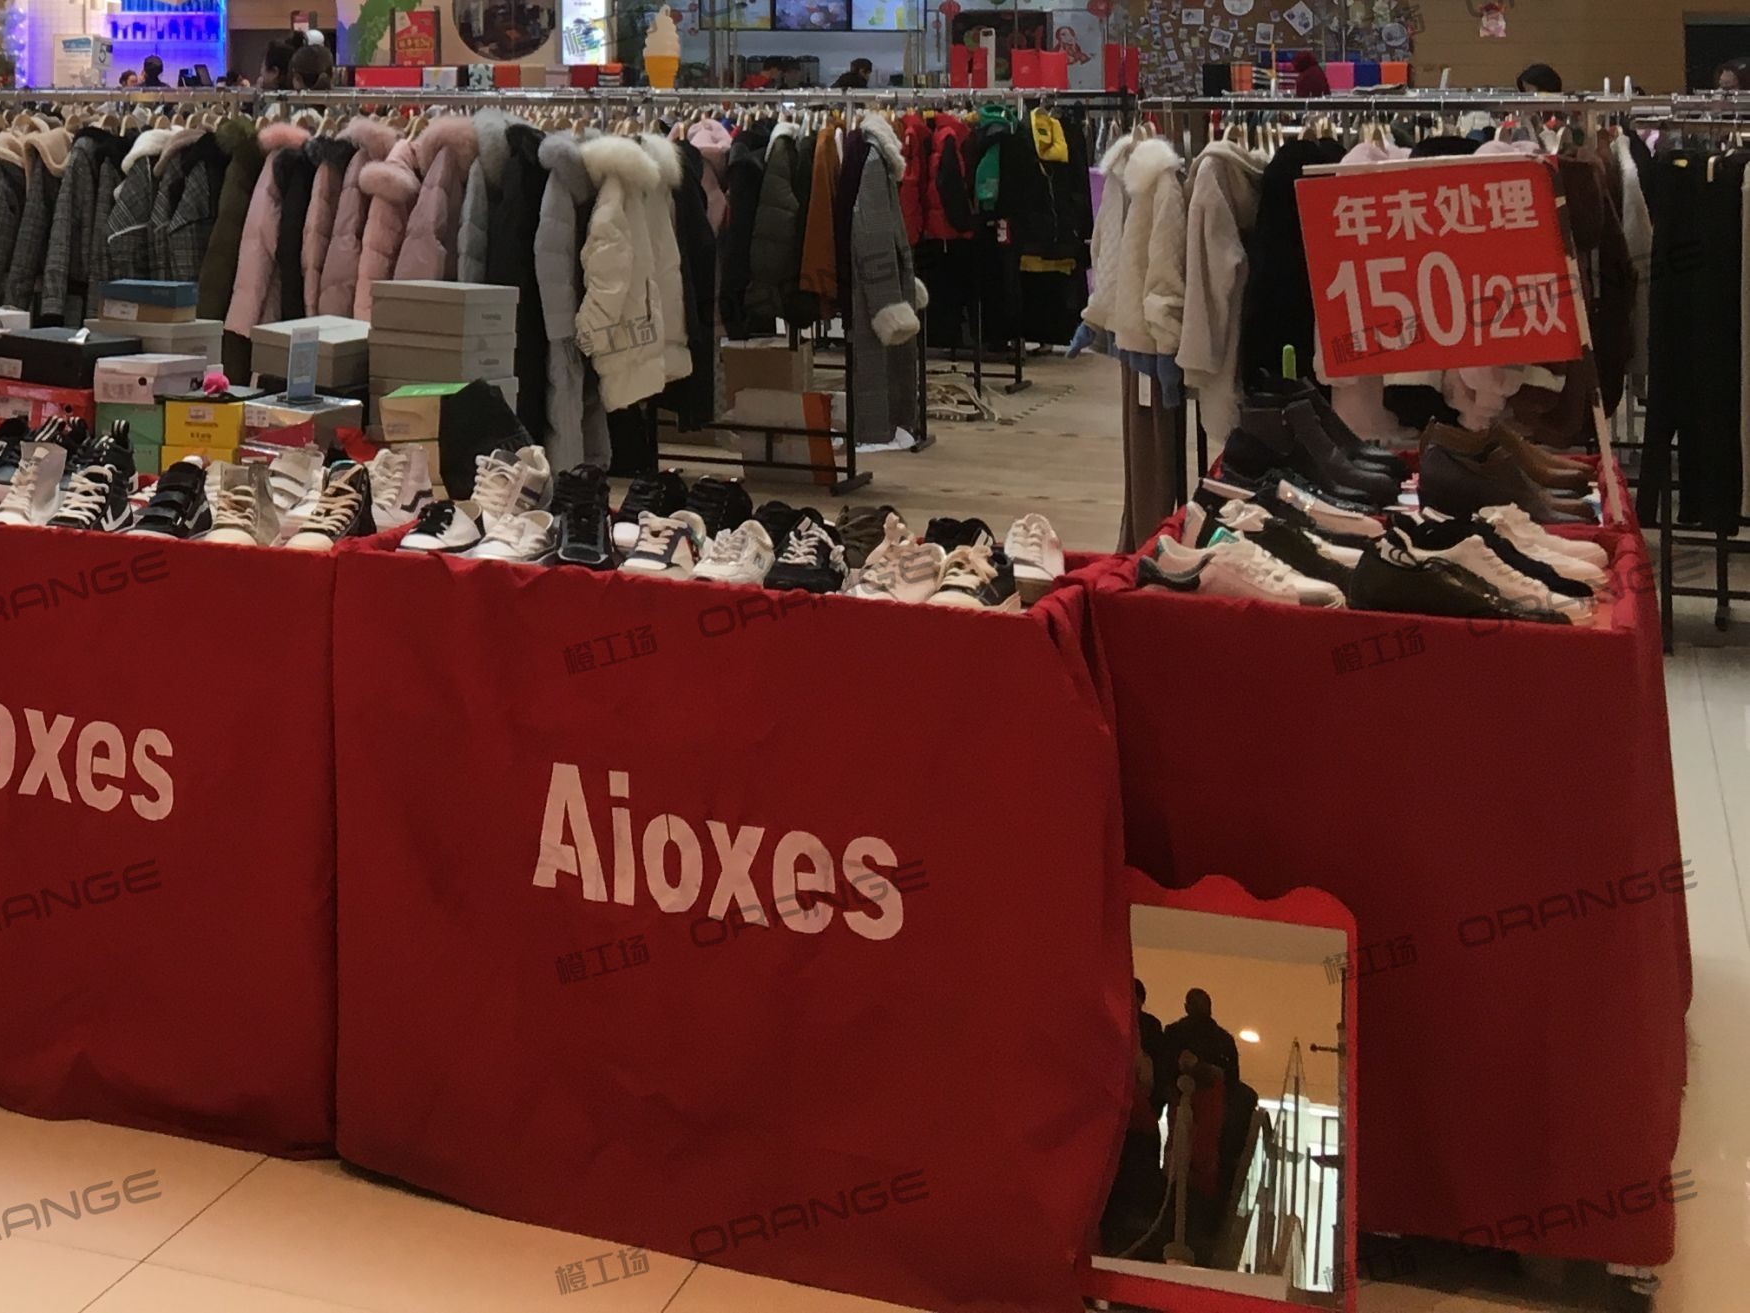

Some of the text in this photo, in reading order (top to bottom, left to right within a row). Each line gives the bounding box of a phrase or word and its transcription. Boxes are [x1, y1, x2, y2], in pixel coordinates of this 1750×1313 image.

[1333, 179, 1539, 245] 年末处理
[532, 762, 904, 941] Aioxes
